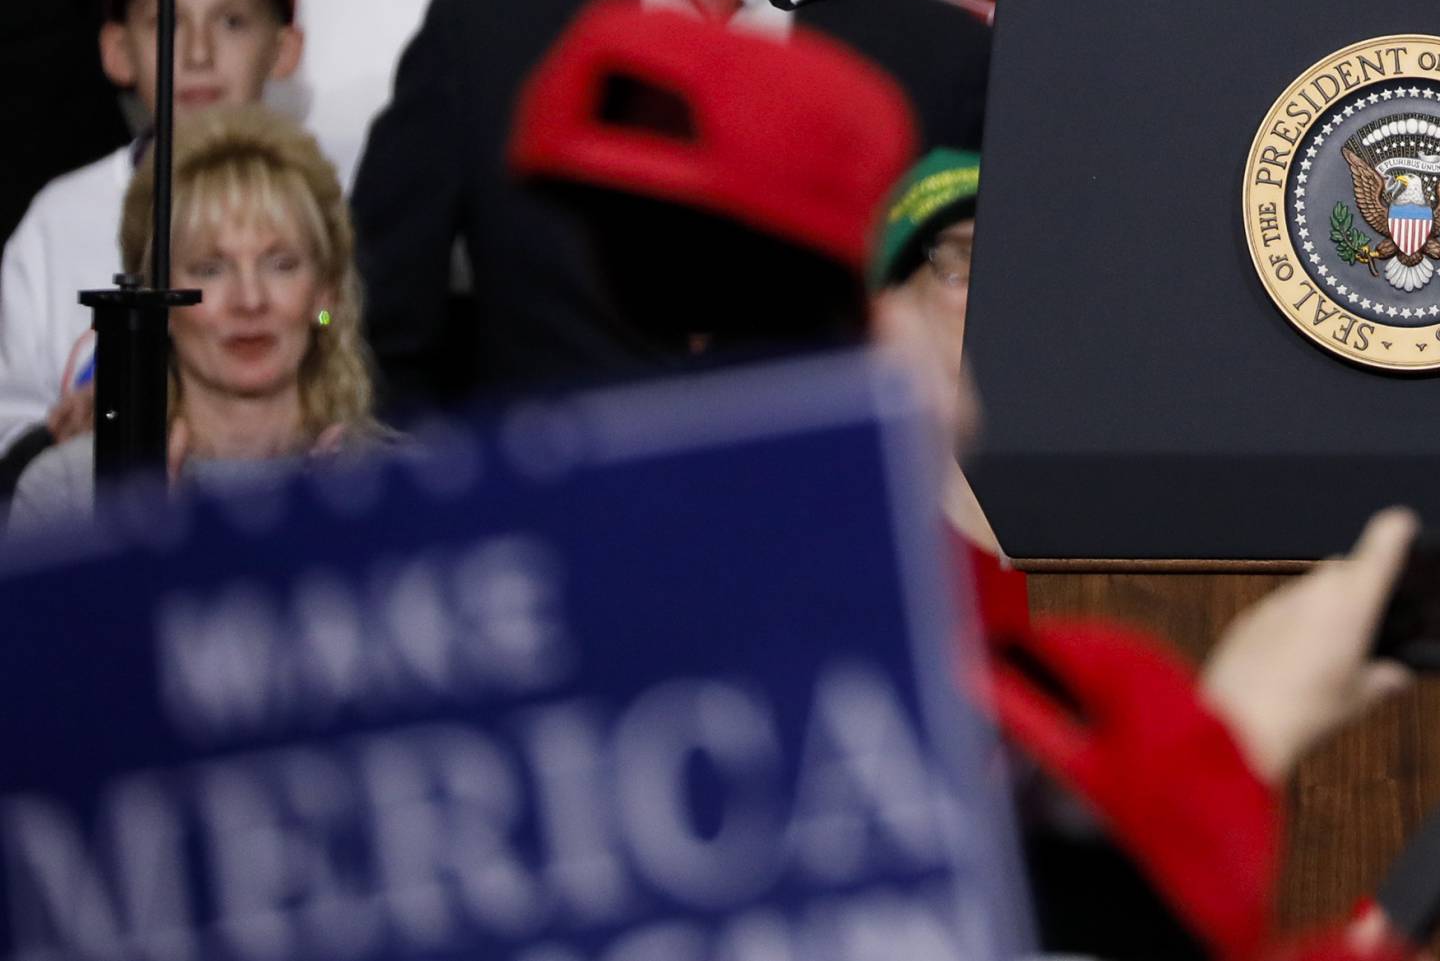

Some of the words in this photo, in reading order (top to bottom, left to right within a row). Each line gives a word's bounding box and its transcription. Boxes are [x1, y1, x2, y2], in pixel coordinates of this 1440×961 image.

[1255, 46, 1408, 190] PRESIDENT
[1258, 201, 1281, 247] THE
[1267, 254, 1295, 283] OF
[1292, 279, 1376, 352] SEAL
